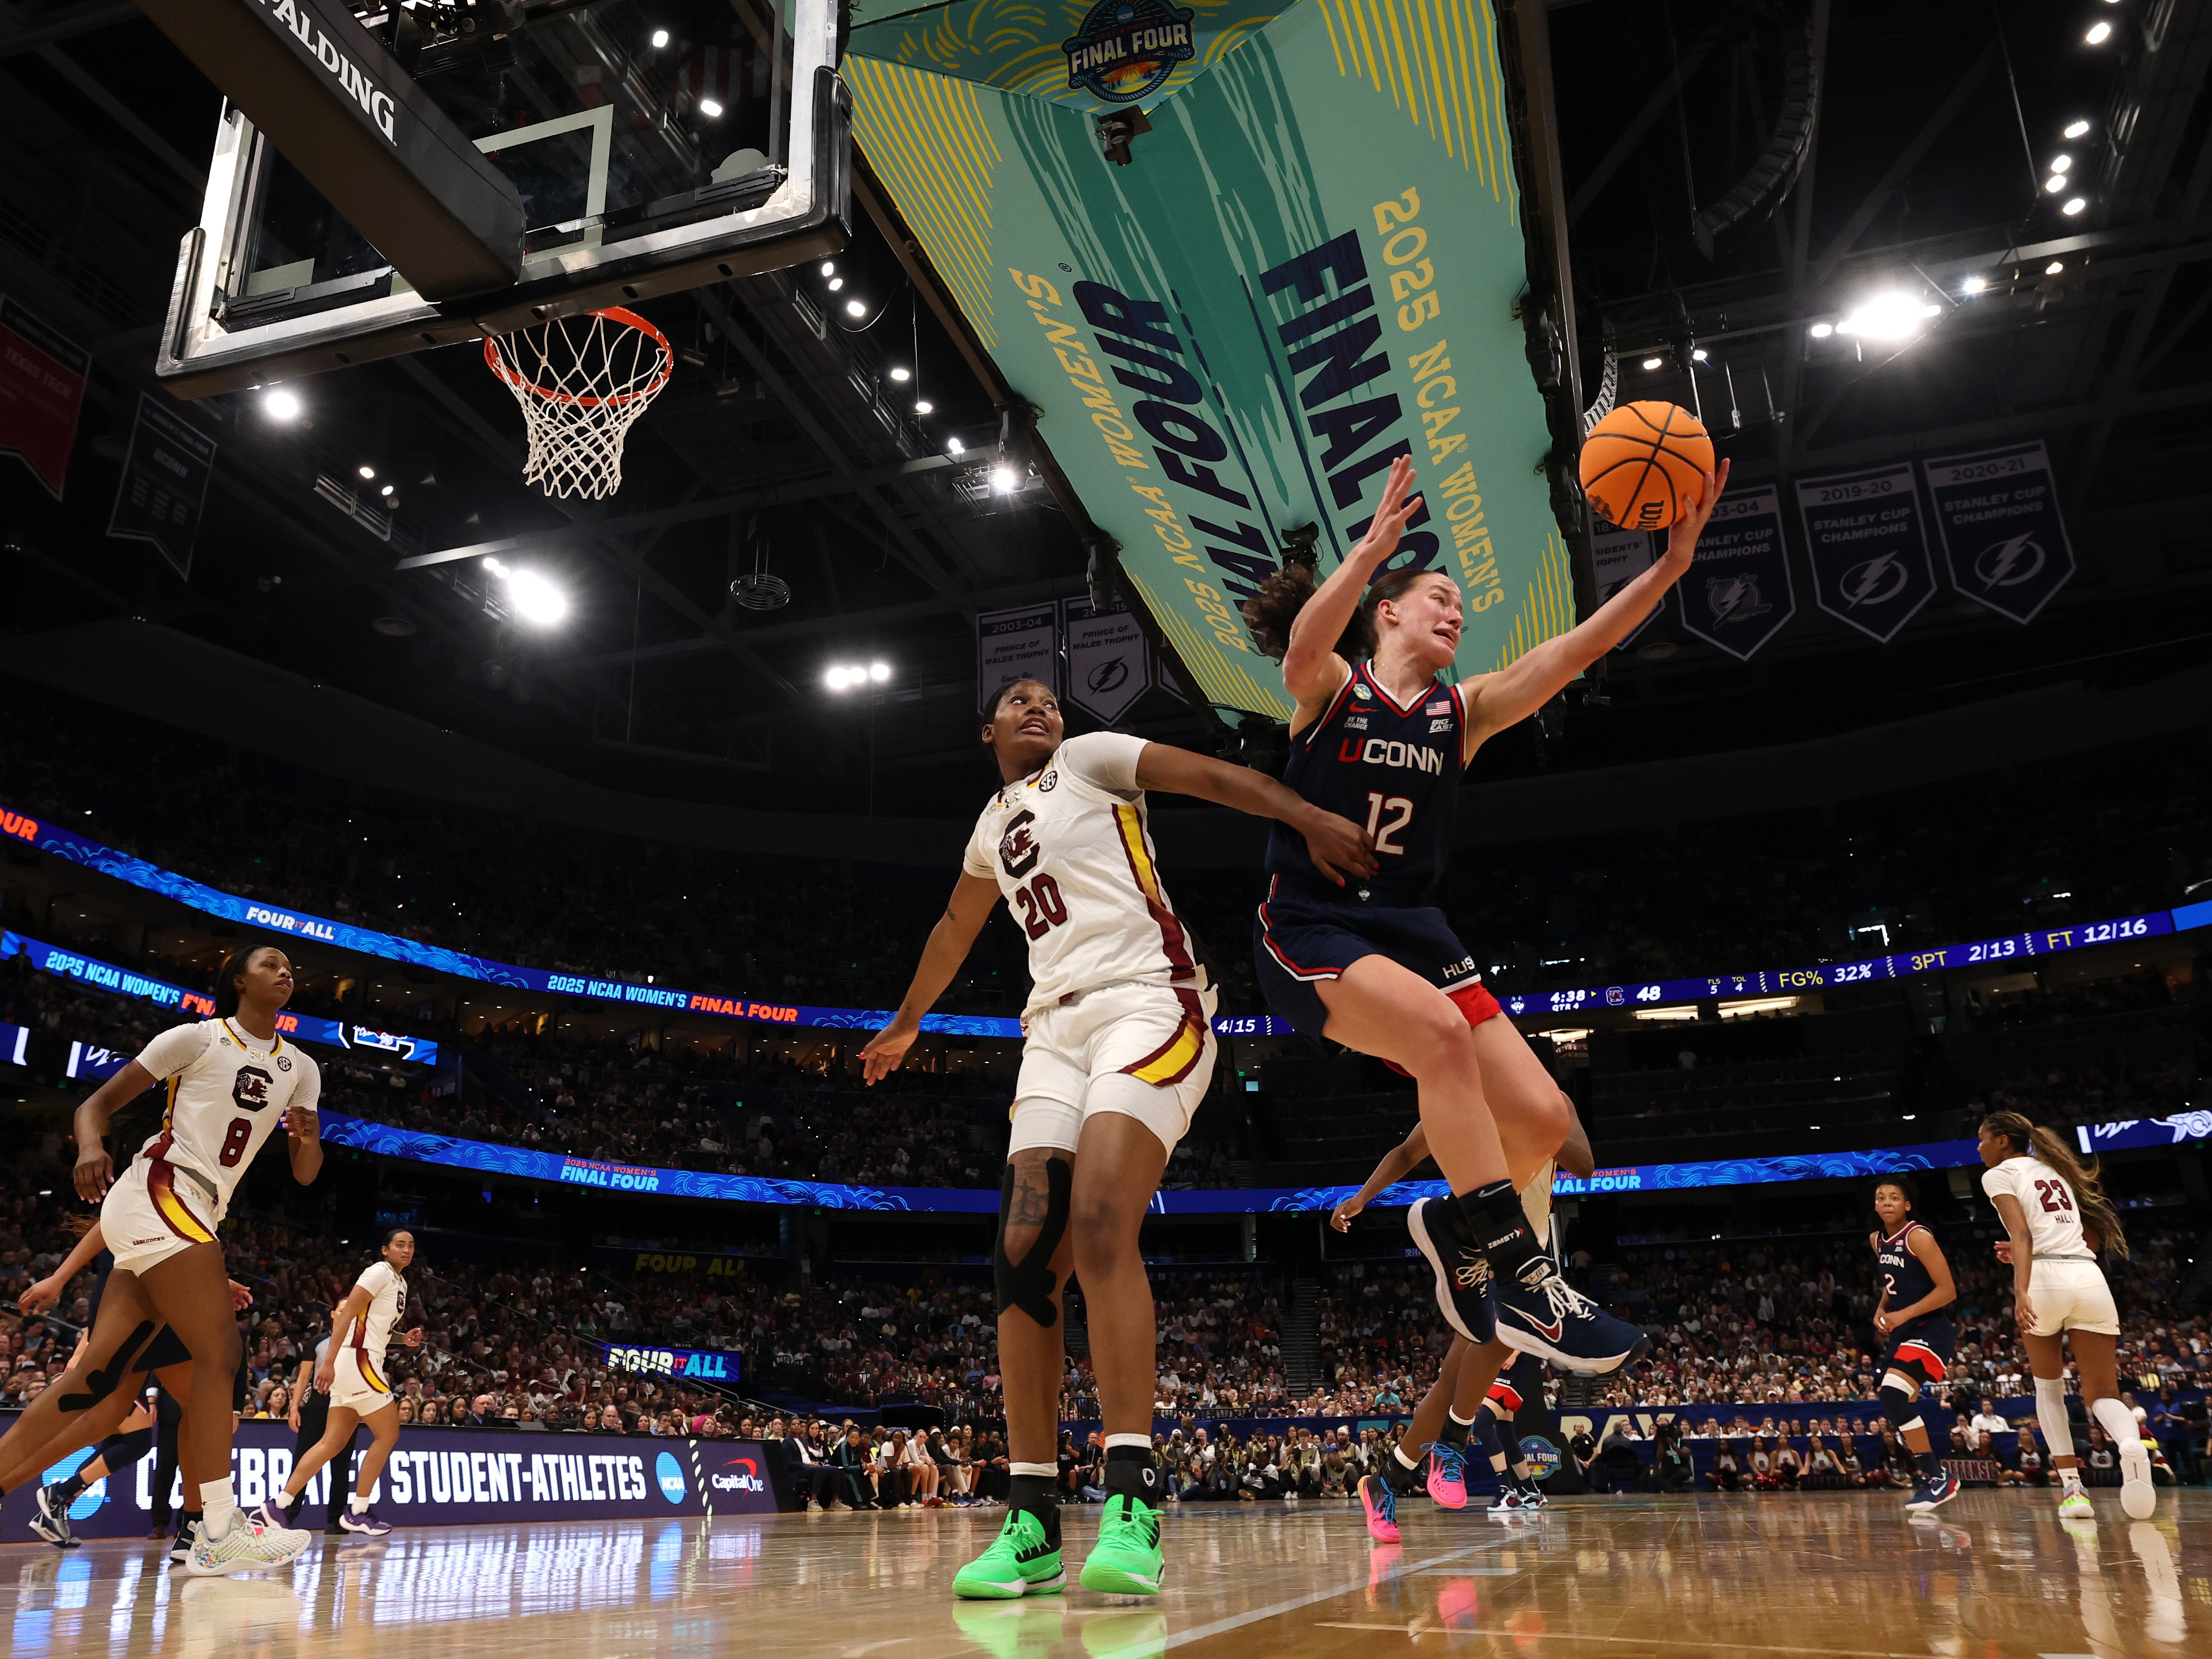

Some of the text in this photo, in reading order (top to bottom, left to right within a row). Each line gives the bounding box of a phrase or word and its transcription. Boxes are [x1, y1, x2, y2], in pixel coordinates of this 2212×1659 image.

[1071, 24, 1188, 73] FINAL FOUR
[258, 0, 394, 143] ALDING
[1259, 229, 1413, 511] FINAL
[1073, 280, 1253, 511] FOUR
[1373, 186, 1506, 613] 2025 NCAA WOMEN'S
[1008, 267, 1249, 652] 2025 NCAA WOMEN'S
[1951, 458, 2027, 481] 2020-21
[1821, 481, 1892, 502] 2019-20
[1945, 486, 2046, 512] STANLEY CUP
[1711, 501, 1759, 518] 03-04
[1813, 507, 1911, 532] STANLEY CUP
[1953, 501, 2044, 525] CHAMPIONS
[1696, 528, 1774, 548] ANLEY CUP
[1821, 522, 1908, 543] CHAMPIONS
[1692, 543, 1771, 562] HAMPIONS
[991, 617, 1043, 634] 2003-04
[1083, 625, 1129, 639] PRINCE OF
[995, 643, 1026, 654] PRINCE
[1073, 633, 1140, 650] WALES TROPHY
[985, 648, 1050, 666] WALES TROPHY
[1344, 723, 1369, 731] CHANGE
[1338, 738, 1444, 777] UCONN
[1040, 772, 1057, 790] SEC
[1366, 790, 1415, 856] 12
[1016, 872, 1068, 942] 20
[246, 907, 295, 930] FOUR
[301, 921, 335, 940] ALL
[1779, 919, 2148, 988] FG% 32% 3PT 2/13 FT 12/16
[46, 951, 180, 1004] 2025 NCAA WOMEN'S
[1708, 978, 1721, 986] FLS
[1735, 982, 1744, 992] 4
[547, 975, 799, 1023] 2025 NCAA WOMEN'S FINAL FOUR
[1550, 989, 1586, 1004] 4:38
[1636, 985, 1661, 1001] 48
[1711, 986, 1718, 995] 5
[1552, 1003, 1571, 1012] QTR
[1217, 1019, 1256, 1033] 4/15
[279, 1058, 291, 1069] SEC
[219, 1117, 252, 1168] 8
[565, 1158, 657, 1176] 2025 NCAA WOMEN'S
[1592, 1168, 1637, 1177] WOMEN'S
[560, 1165, 659, 1191] FINAL FOUR
[1553, 1175, 1641, 1194] NAL FOUR
[2034, 1179, 2073, 1212] 23
[132, 1236, 165, 1246] GAMECOCKS
[1880, 1253, 1905, 1268] CONN
[1883, 1273, 1897, 1295] 2
[607, 1347, 727, 1379] FOUR IT ALL
[1537, 1452, 1559, 1463] FOUR
[390, 1450, 647, 1505] STUDENT-ATHLETES
[661, 1477, 686, 1491] NCAA
